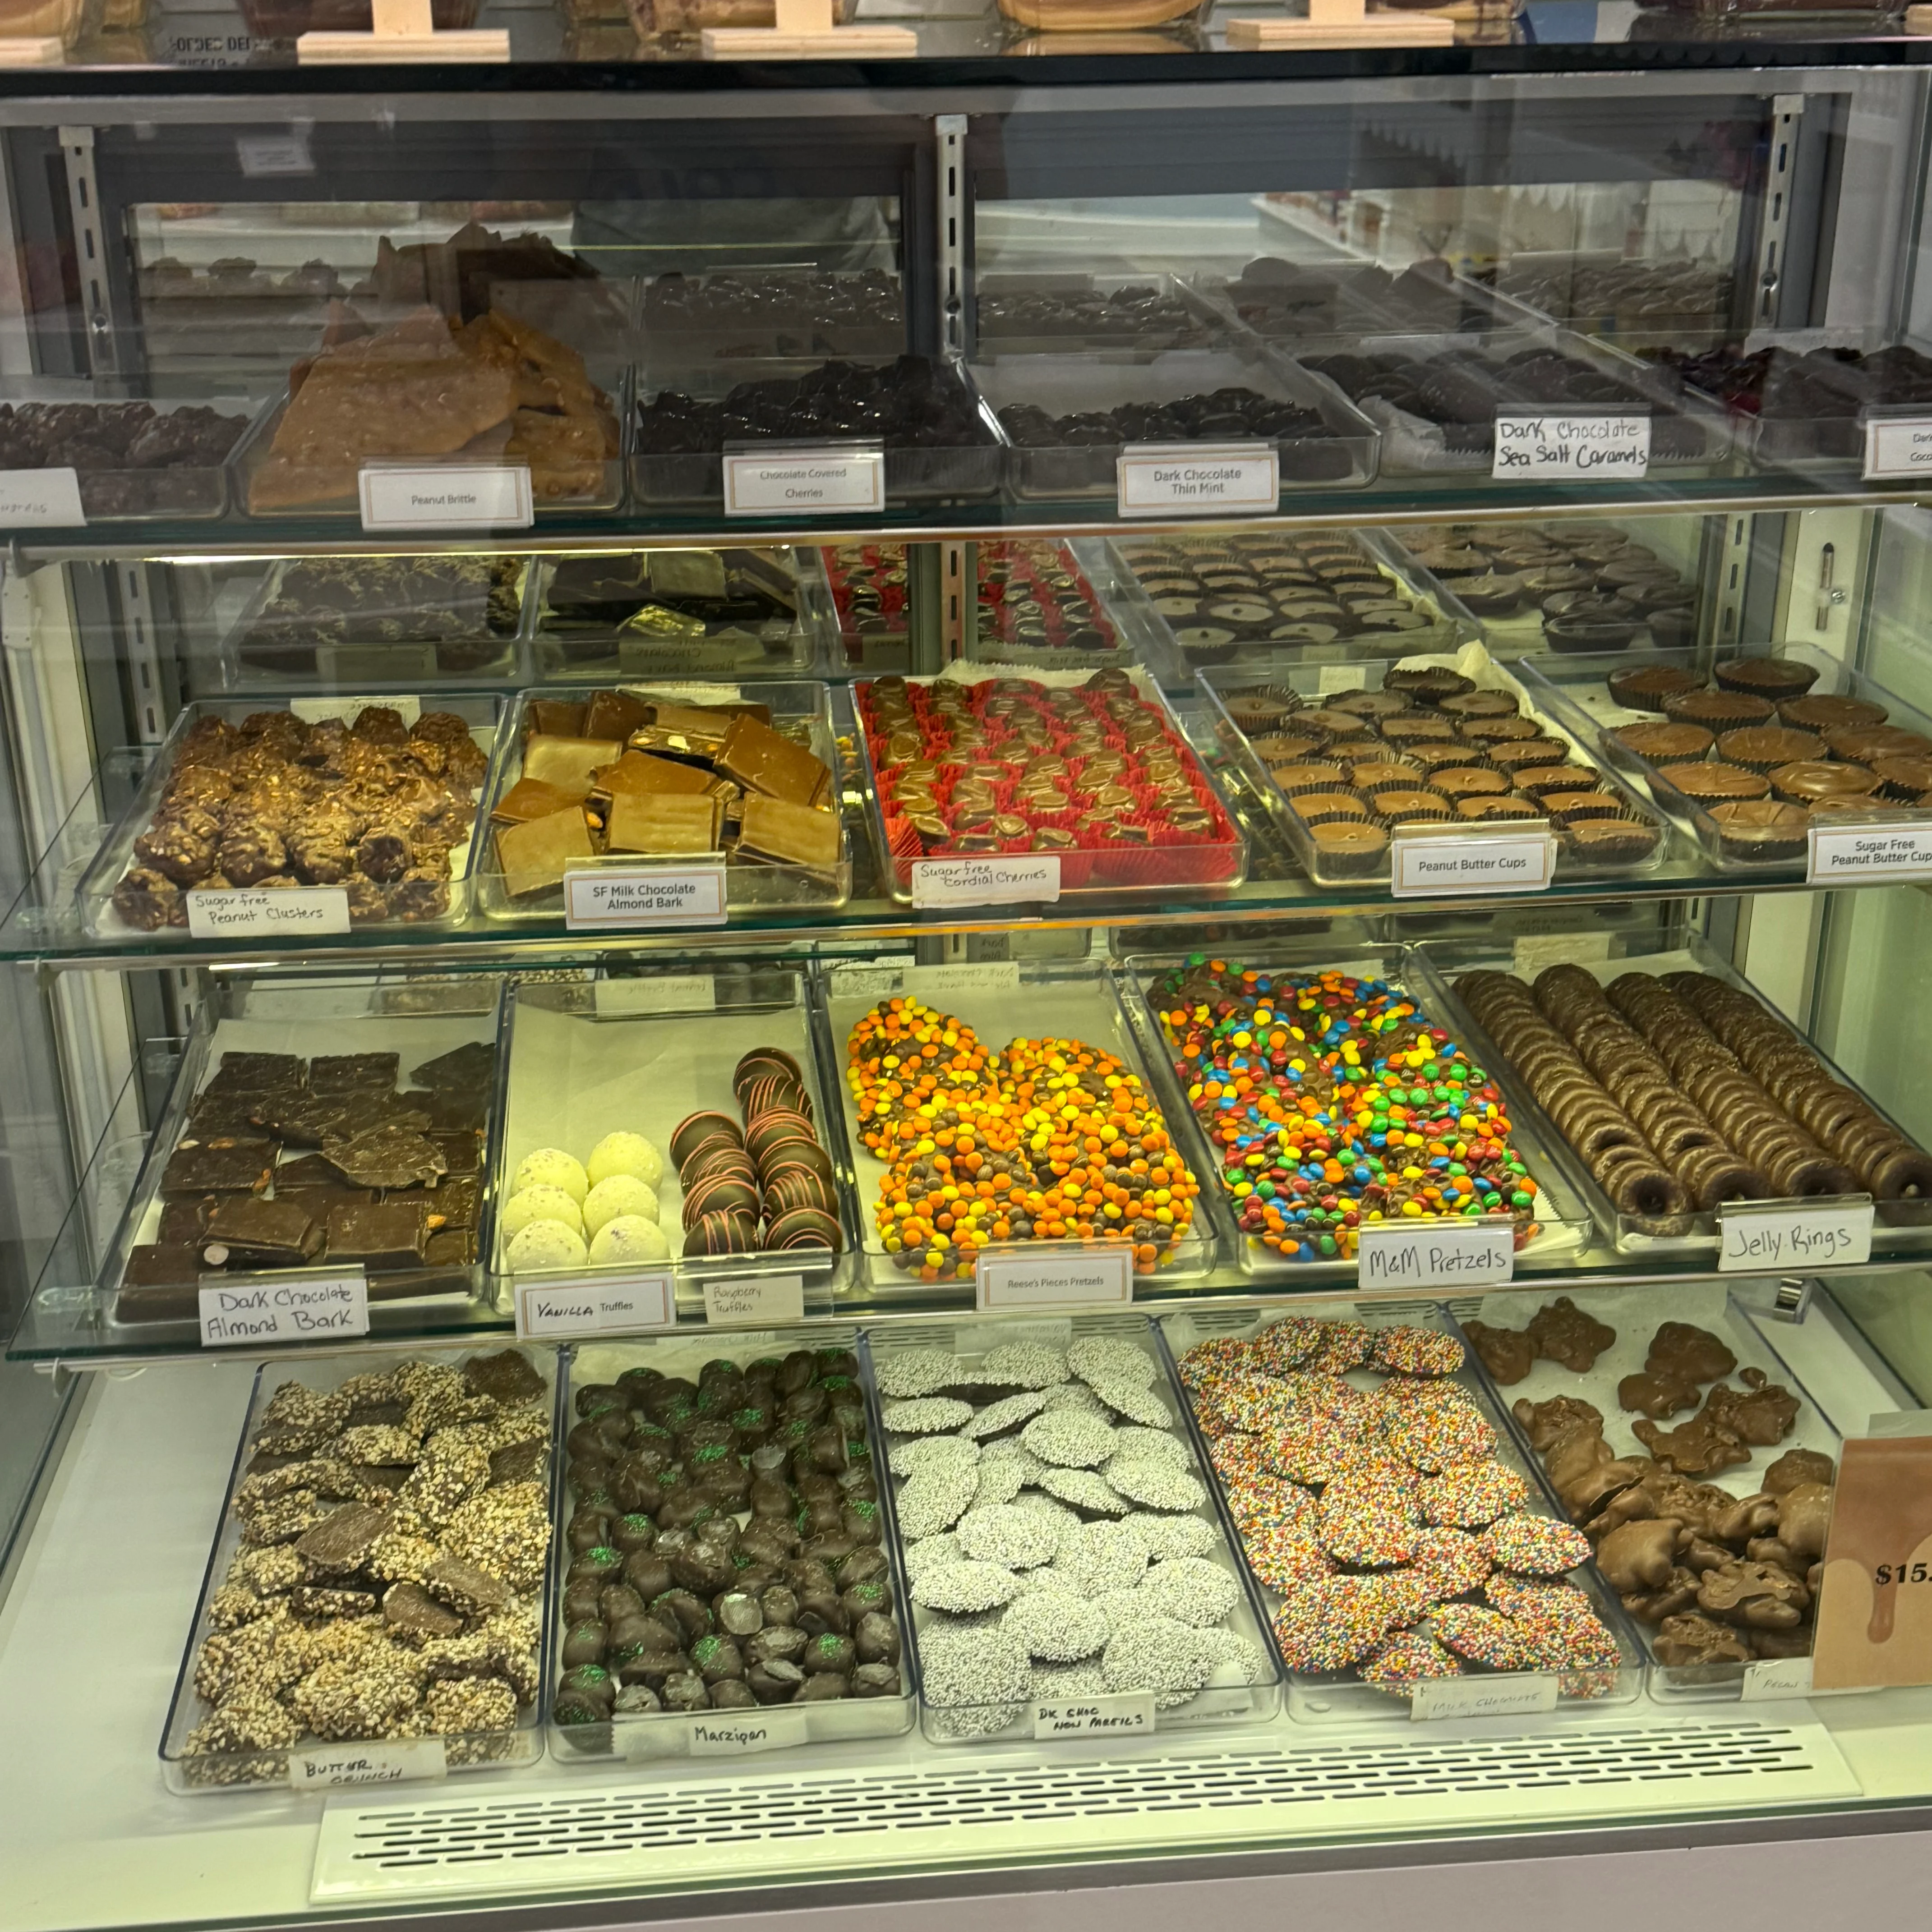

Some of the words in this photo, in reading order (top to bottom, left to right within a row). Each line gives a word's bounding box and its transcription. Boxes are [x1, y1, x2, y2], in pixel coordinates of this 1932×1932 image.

[1500, 418, 1546, 442] Dark
[1557, 419, 1640, 440] Chocolate
[1499, 445, 1531, 466] Sea
[1536, 444, 1571, 463] Salt
[1576, 444, 1646, 468] Caramels
[760, 470, 807, 480] Chocolate
[808, 468, 847, 478] Covered
[1154, 470, 1180, 482] Dark
[1184, 468, 1242, 481] Chocolate
[785, 488, 823, 498] Cherries
[1171, 483, 1196, 495] Thin
[1200, 482, 1225, 494] Mint
[412, 495, 445, 506] Peanut
[448, 493, 476, 504] Brittle
[1855, 841, 1888, 852] Sugar
[1891, 839, 1915, 850] Free
[1419, 860, 1457, 872] Peanut
[1461, 859, 1496, 870] Butter
[1499, 857, 1526, 870] Cups
[1831, 853, 1870, 865] Peanut
[1873, 853, 1908, 864] Butter
[921, 863, 962, 879] Sugar
[996, 869, 1047, 883] Cherries
[593, 886, 608, 897] SF
[611, 885, 634, 897] Milk
[638, 883, 696, 896] Chocolate
[195, 895, 236, 911] Sugar
[607, 898, 654, 910] Almond
[657, 897, 683, 908] Bark
[208, 911, 258, 925] Peanut
[266, 907, 323, 920] Clusters
[1729, 1229, 1781, 1261] Jelly
[1791, 1225, 1852, 1258] Rings
[1370, 1246, 1421, 1278] M&M
[1429, 1247, 1506, 1273] Pretzels
[1008, 1279, 1039, 1288] Reese's
[1041, 1278, 1069, 1288] Pieces
[1070, 1276, 1104, 1286] Pretzels
[218, 1291, 269, 1311] Dark
[275, 1284, 353, 1306] Chocolate
[538, 1302, 594, 1318] VANILLA
[599, 1302, 634, 1312] Truffles
[207, 1315, 277, 1338] Almond
[291, 1309, 353, 1330] Bark
[1039, 1708, 1058, 1720] DK
[1066, 1707, 1099, 1718] CHOC
[695, 1726, 767, 1745] Marzipan
